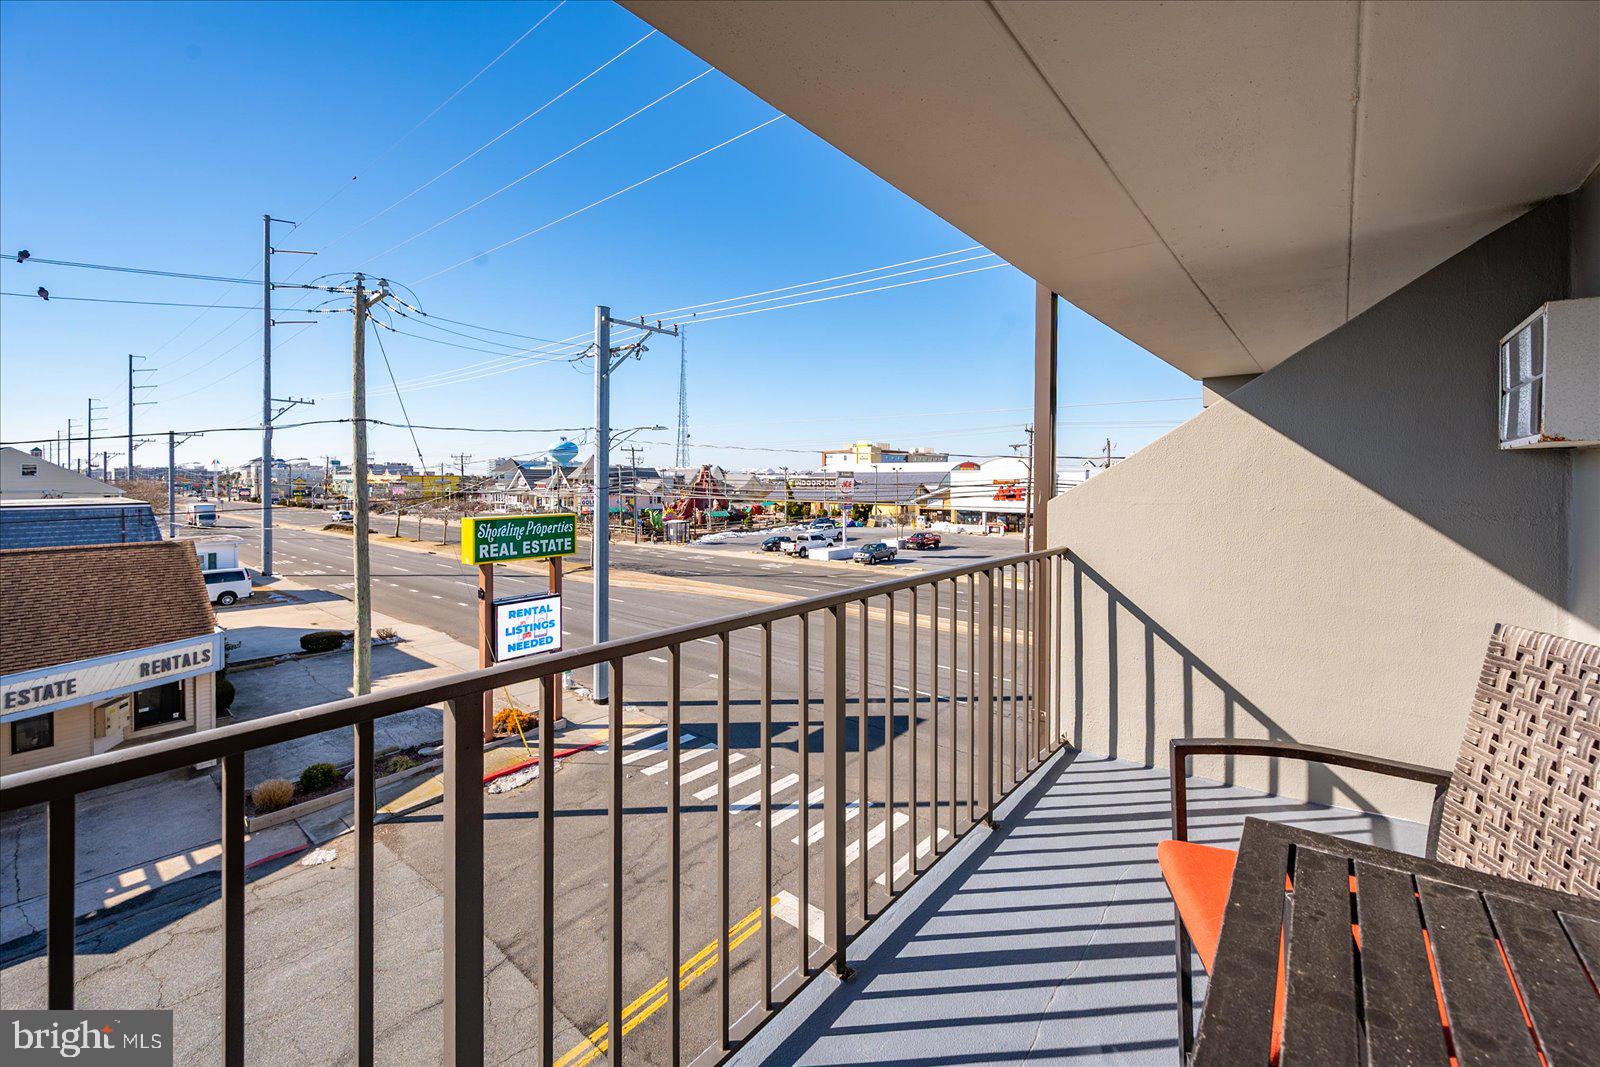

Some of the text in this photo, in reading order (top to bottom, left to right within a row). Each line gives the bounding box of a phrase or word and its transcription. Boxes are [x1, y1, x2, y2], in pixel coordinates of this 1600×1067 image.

[477, 520, 574, 543] Shoreline Properties
[479, 537, 572, 559] REAL ESTATE
[508, 604, 553, 619] RENTAL
[505, 619, 556, 637] LISTINGS
[507, 635, 554, 653] NEEDED
[4, 648, 211, 709] ESTATE RENTALS
